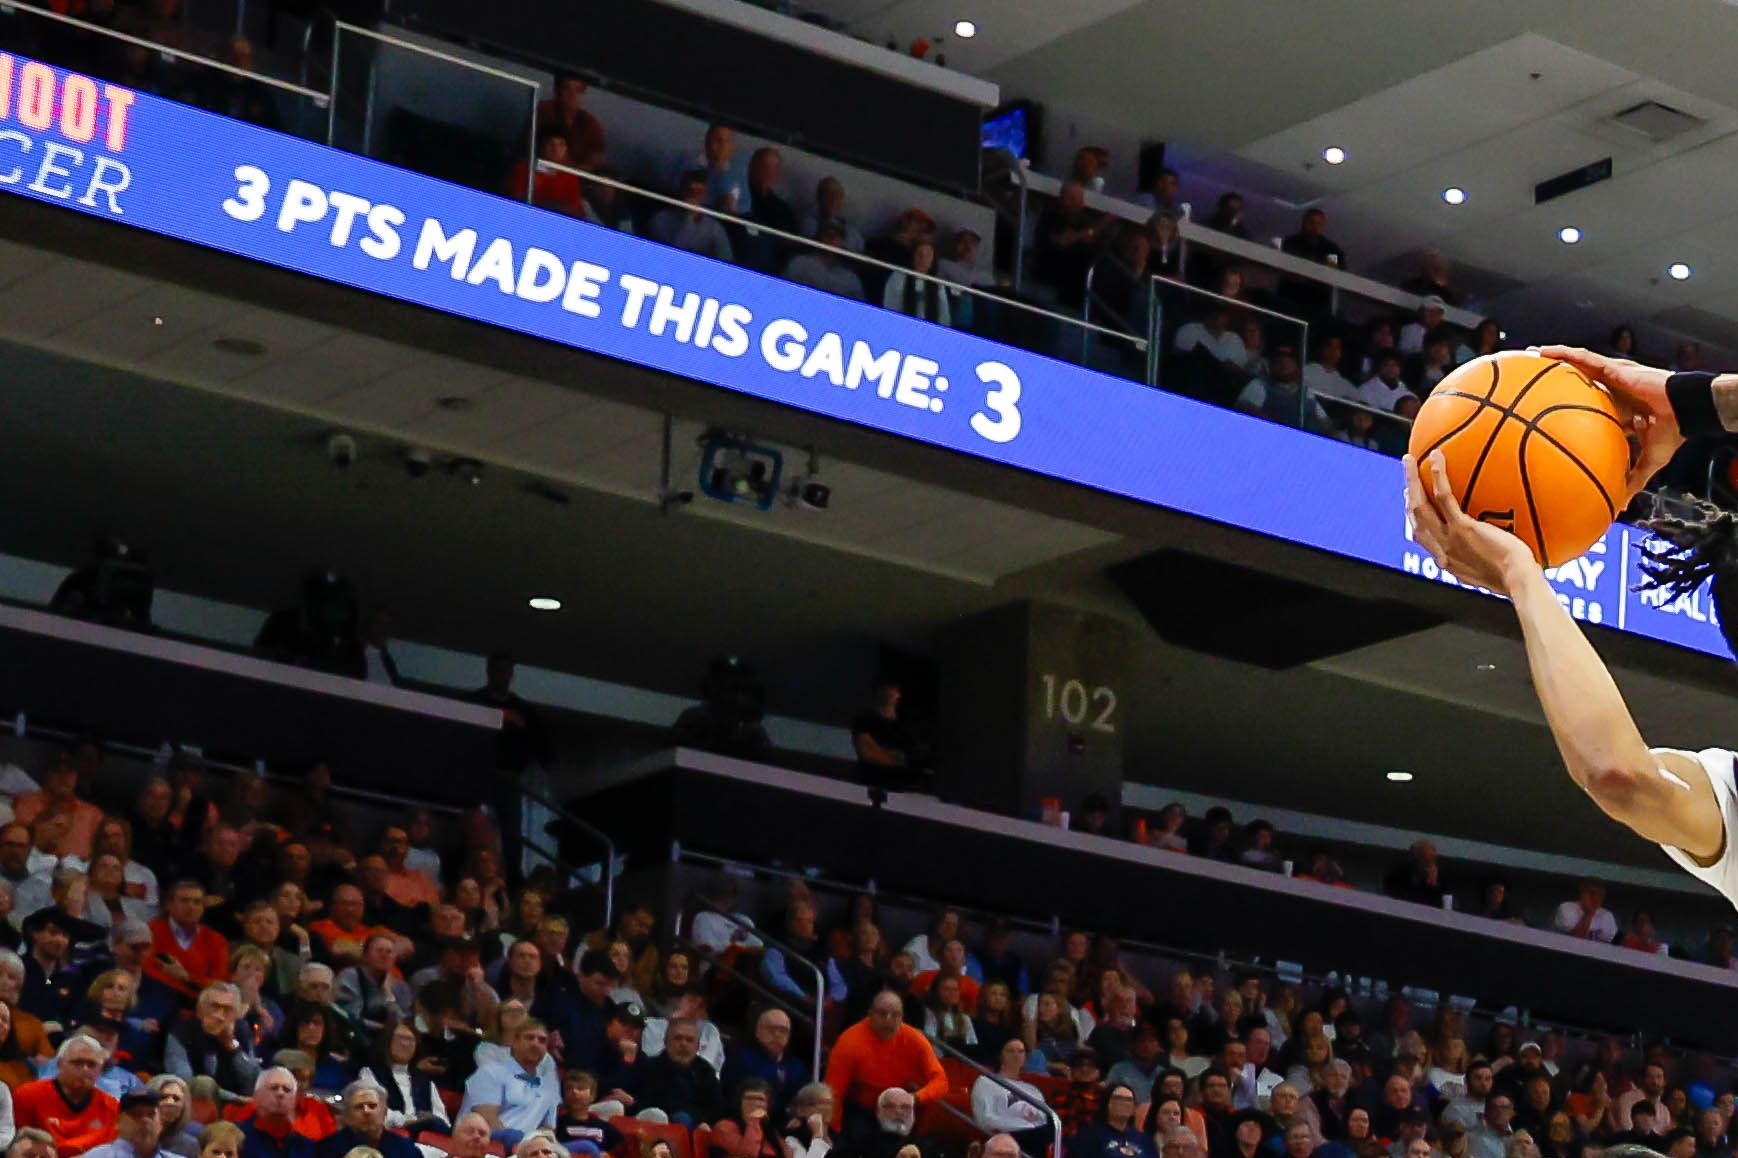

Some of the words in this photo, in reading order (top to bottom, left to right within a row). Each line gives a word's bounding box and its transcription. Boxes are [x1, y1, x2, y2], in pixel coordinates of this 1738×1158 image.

[221, 164, 271, 221] 3
[276, 178, 406, 261] PTS
[412, 217, 611, 318] MADE
[619, 273, 753, 357] THIS
[760, 317, 950, 413] GAME:
[969, 360, 1022, 443] 3
[1042, 674, 1117, 733] 102
